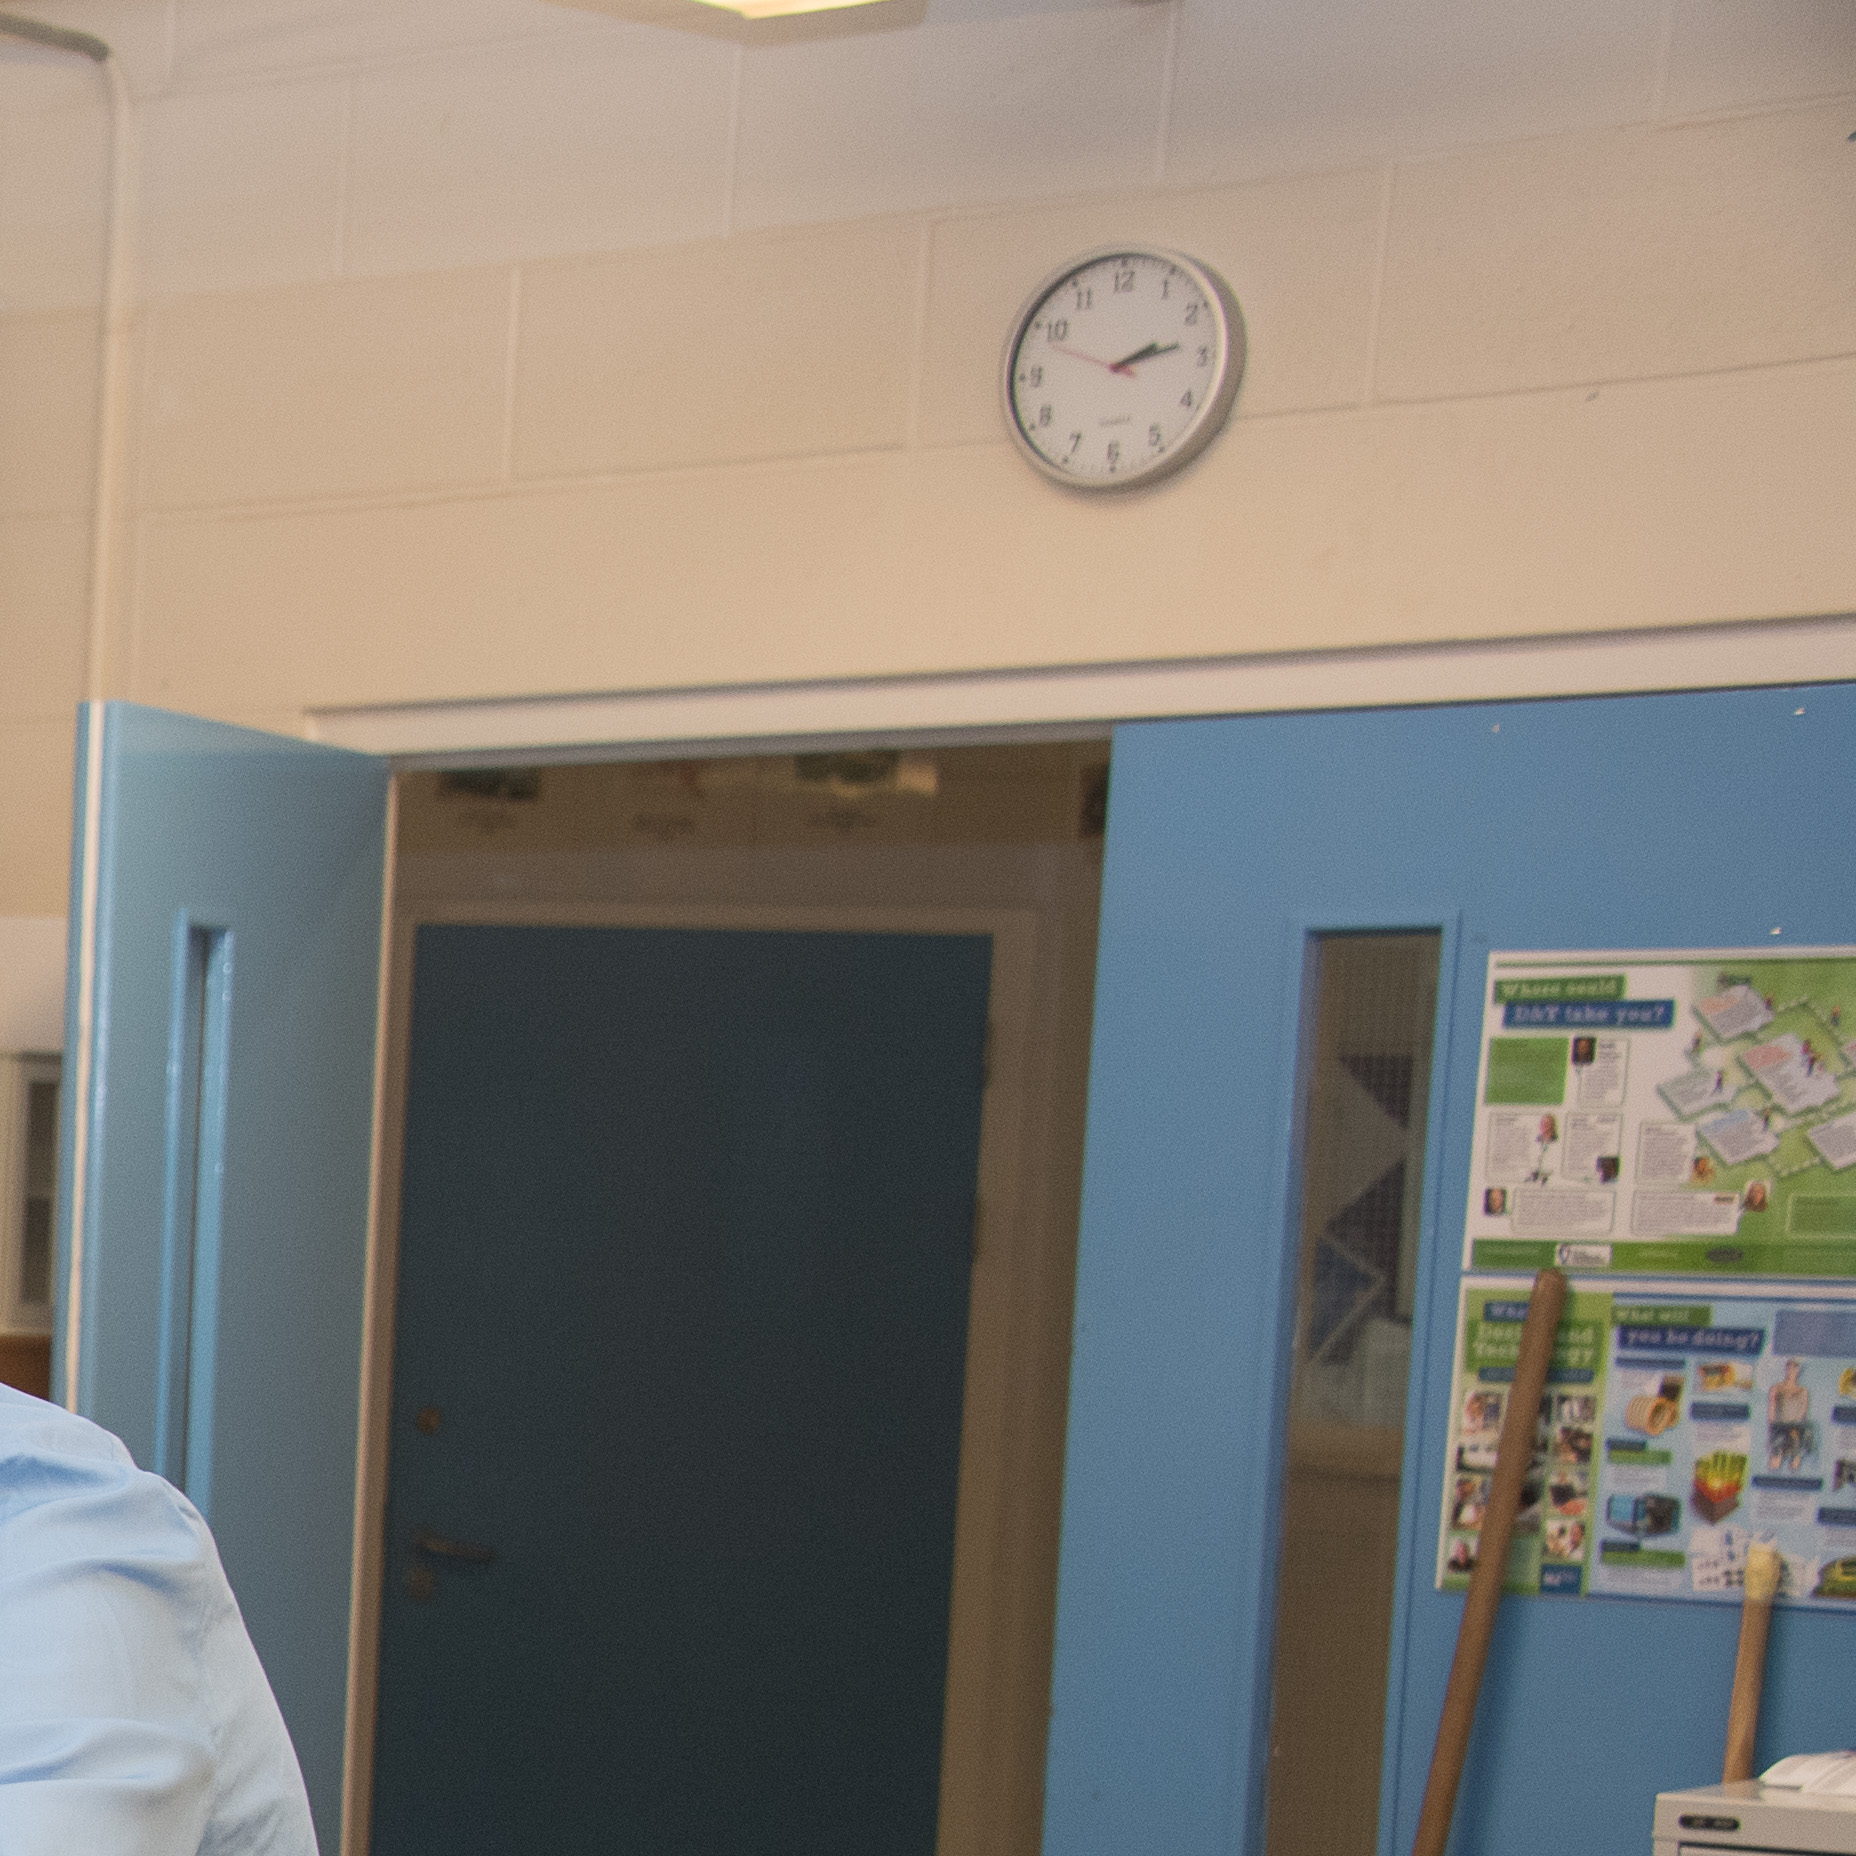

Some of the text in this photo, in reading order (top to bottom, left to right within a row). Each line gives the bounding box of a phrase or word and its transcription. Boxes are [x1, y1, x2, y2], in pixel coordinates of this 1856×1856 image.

[1114, 271, 1135, 292] 12
[1076, 288, 1091, 310] 11
[1185, 303, 1198, 326] 2
[1047, 319, 1068, 342] 10
[1196, 345, 1208, 367] 3
[1181, 390, 1192, 407] 4
[1039, 404, 1052, 427] 8
[1070, 432, 1082, 452] 7
[1148, 423, 1161, 447] 5
[1107, 440, 1120, 464] 6
